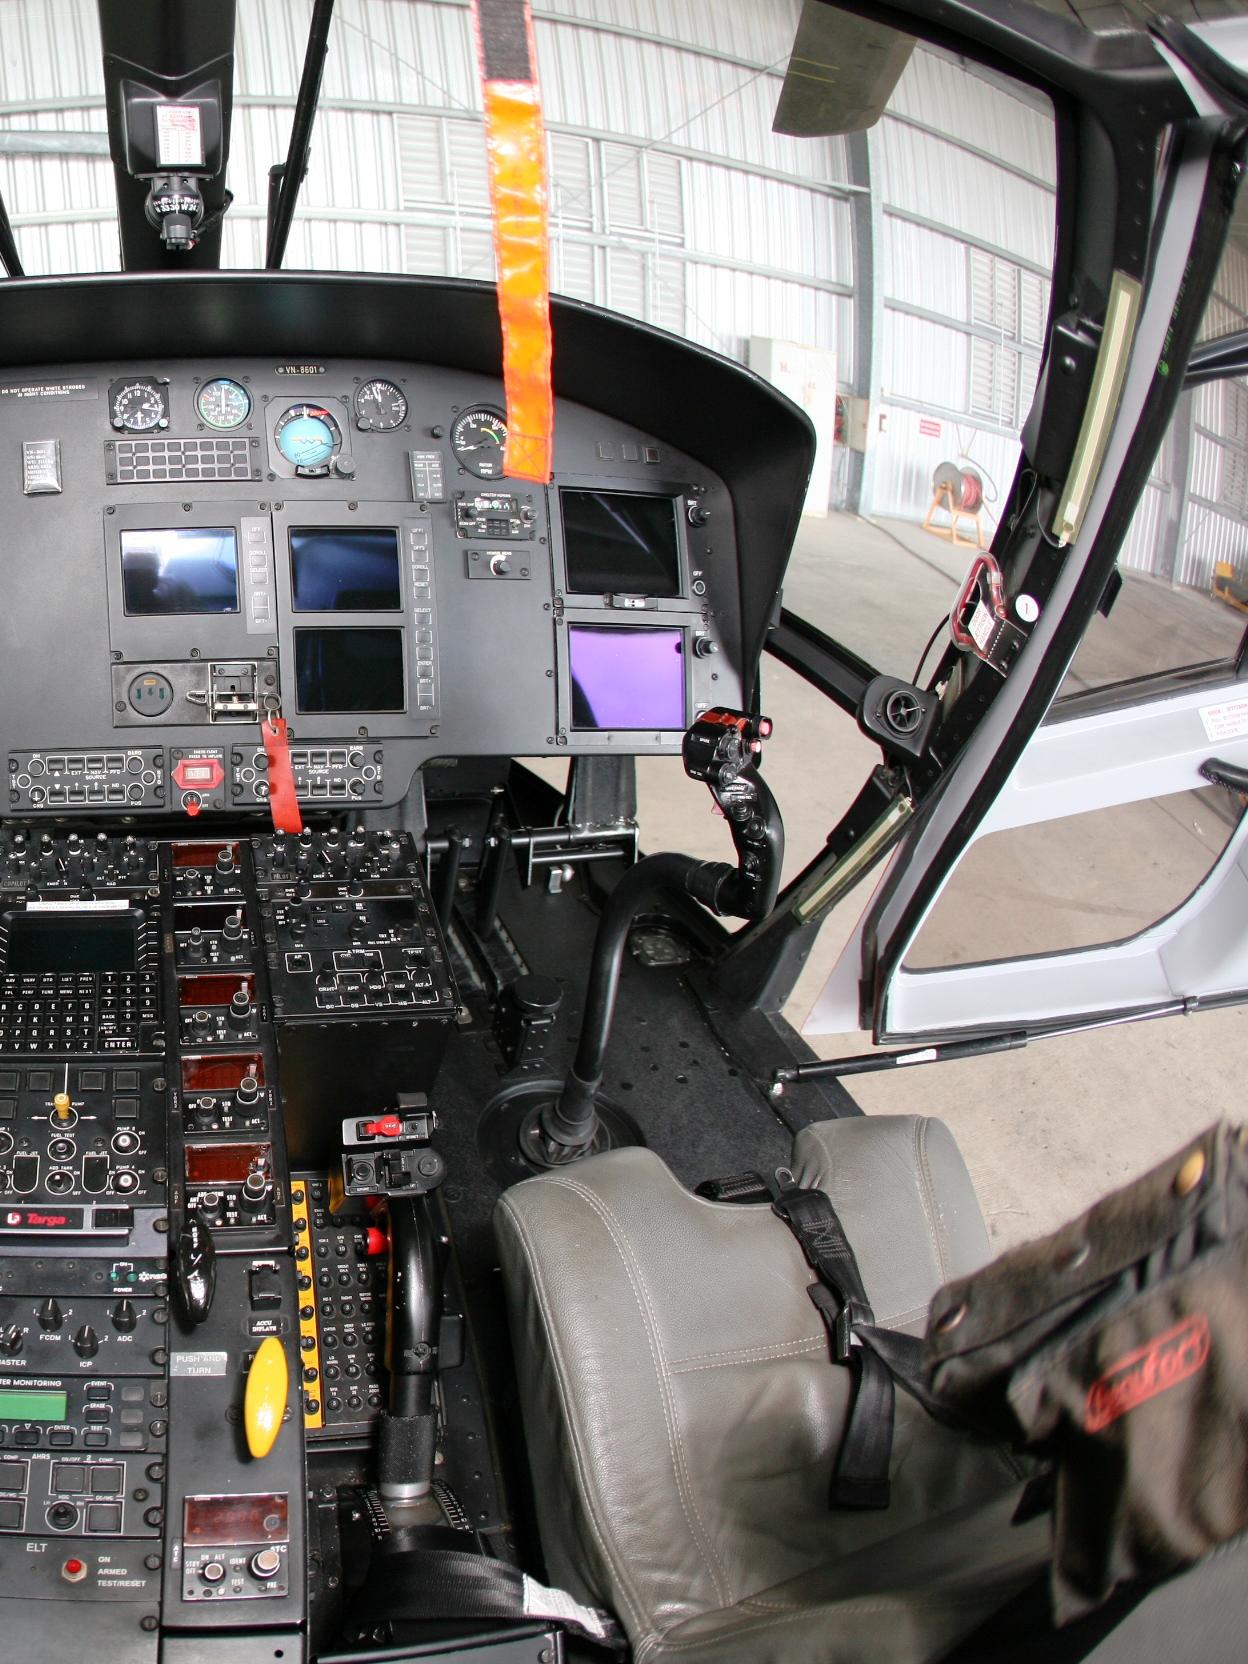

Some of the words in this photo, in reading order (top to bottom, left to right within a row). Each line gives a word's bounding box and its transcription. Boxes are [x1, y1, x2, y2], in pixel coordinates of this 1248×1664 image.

[27, 1213, 67, 1226] Targa
[13, 1379, 62, 1387] MONITORING
[26, 1542, 48, 1553] ELT
[97, 1579, 146, 1587] TEST/RESET
